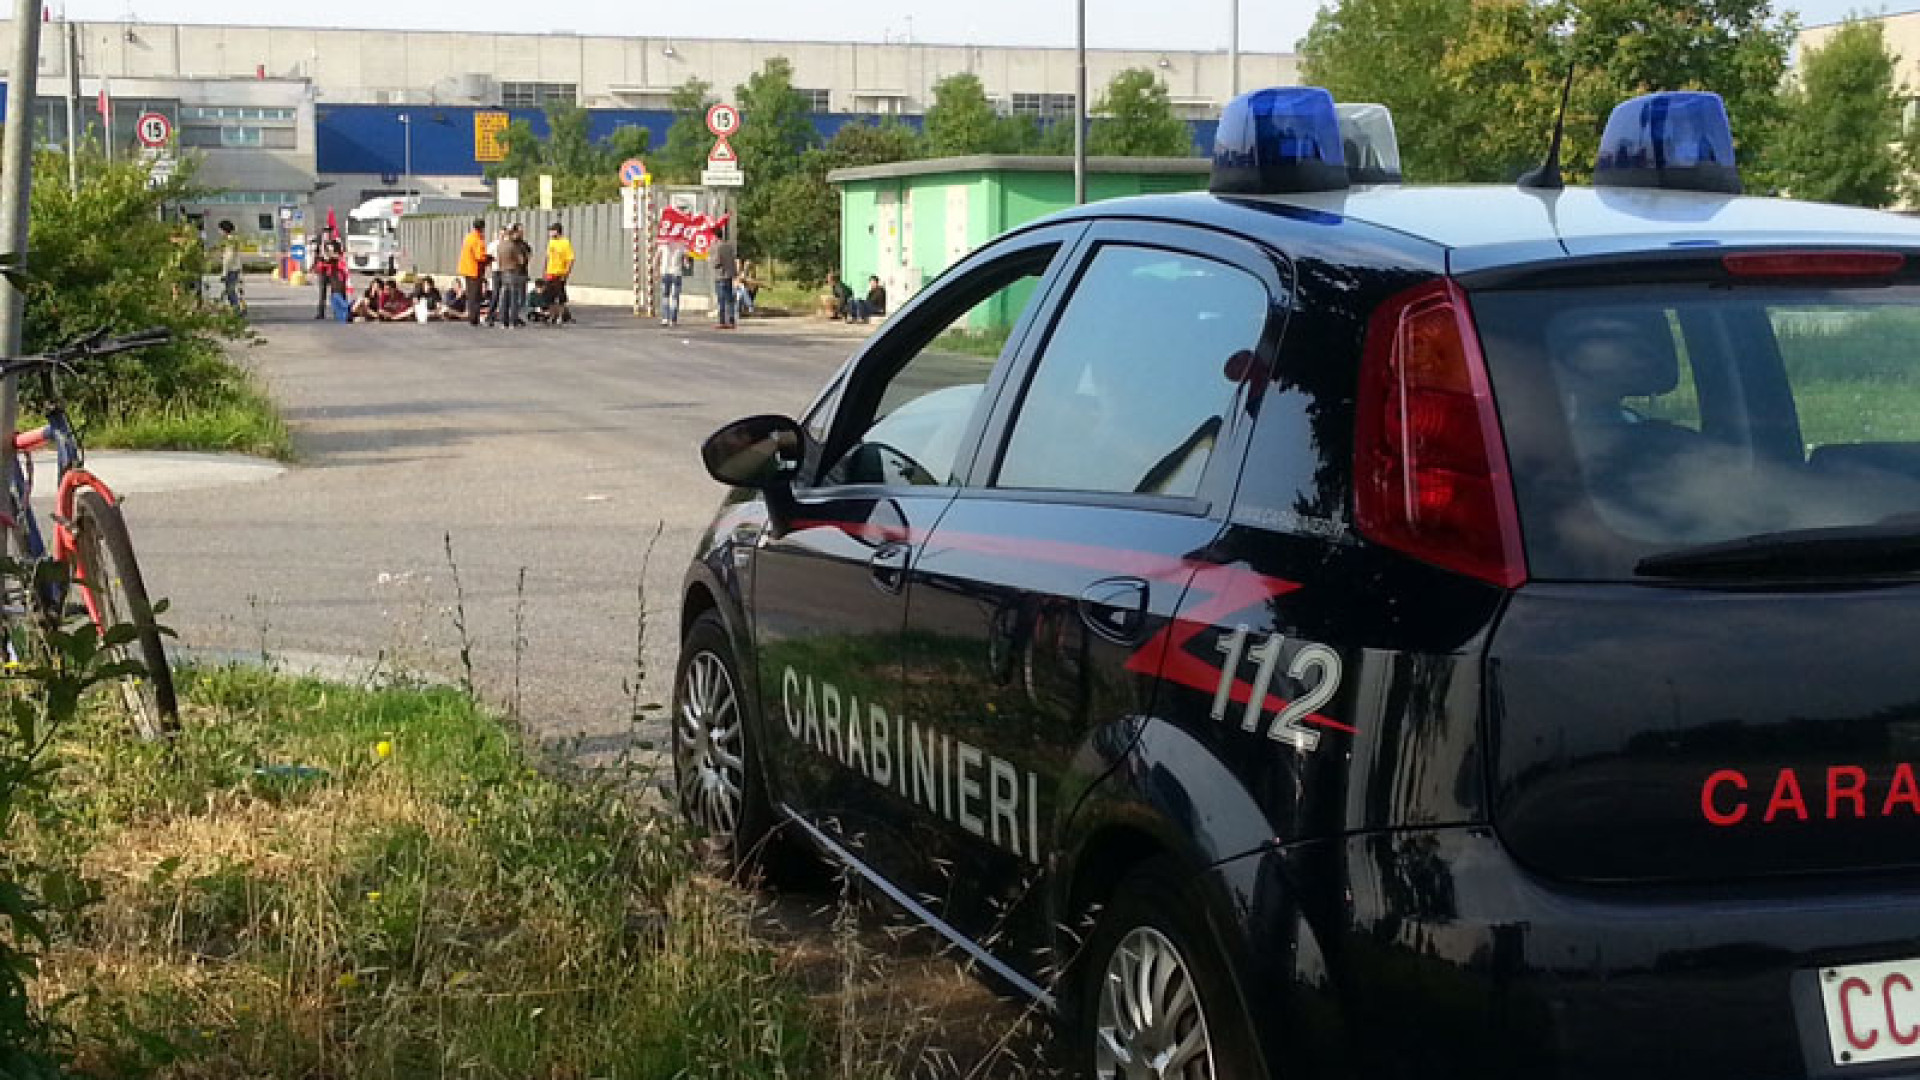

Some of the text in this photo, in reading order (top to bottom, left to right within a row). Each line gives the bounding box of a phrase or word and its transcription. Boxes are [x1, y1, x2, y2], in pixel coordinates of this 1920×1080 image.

[146, 122, 162, 138] 15
[717, 112, 731, 128] 15
[1210, 624, 1345, 752] 112
[783, 664, 1039, 865] CARABINIERI
[1701, 762, 1920, 827] CARA
[1838, 973, 1920, 1050] CC
